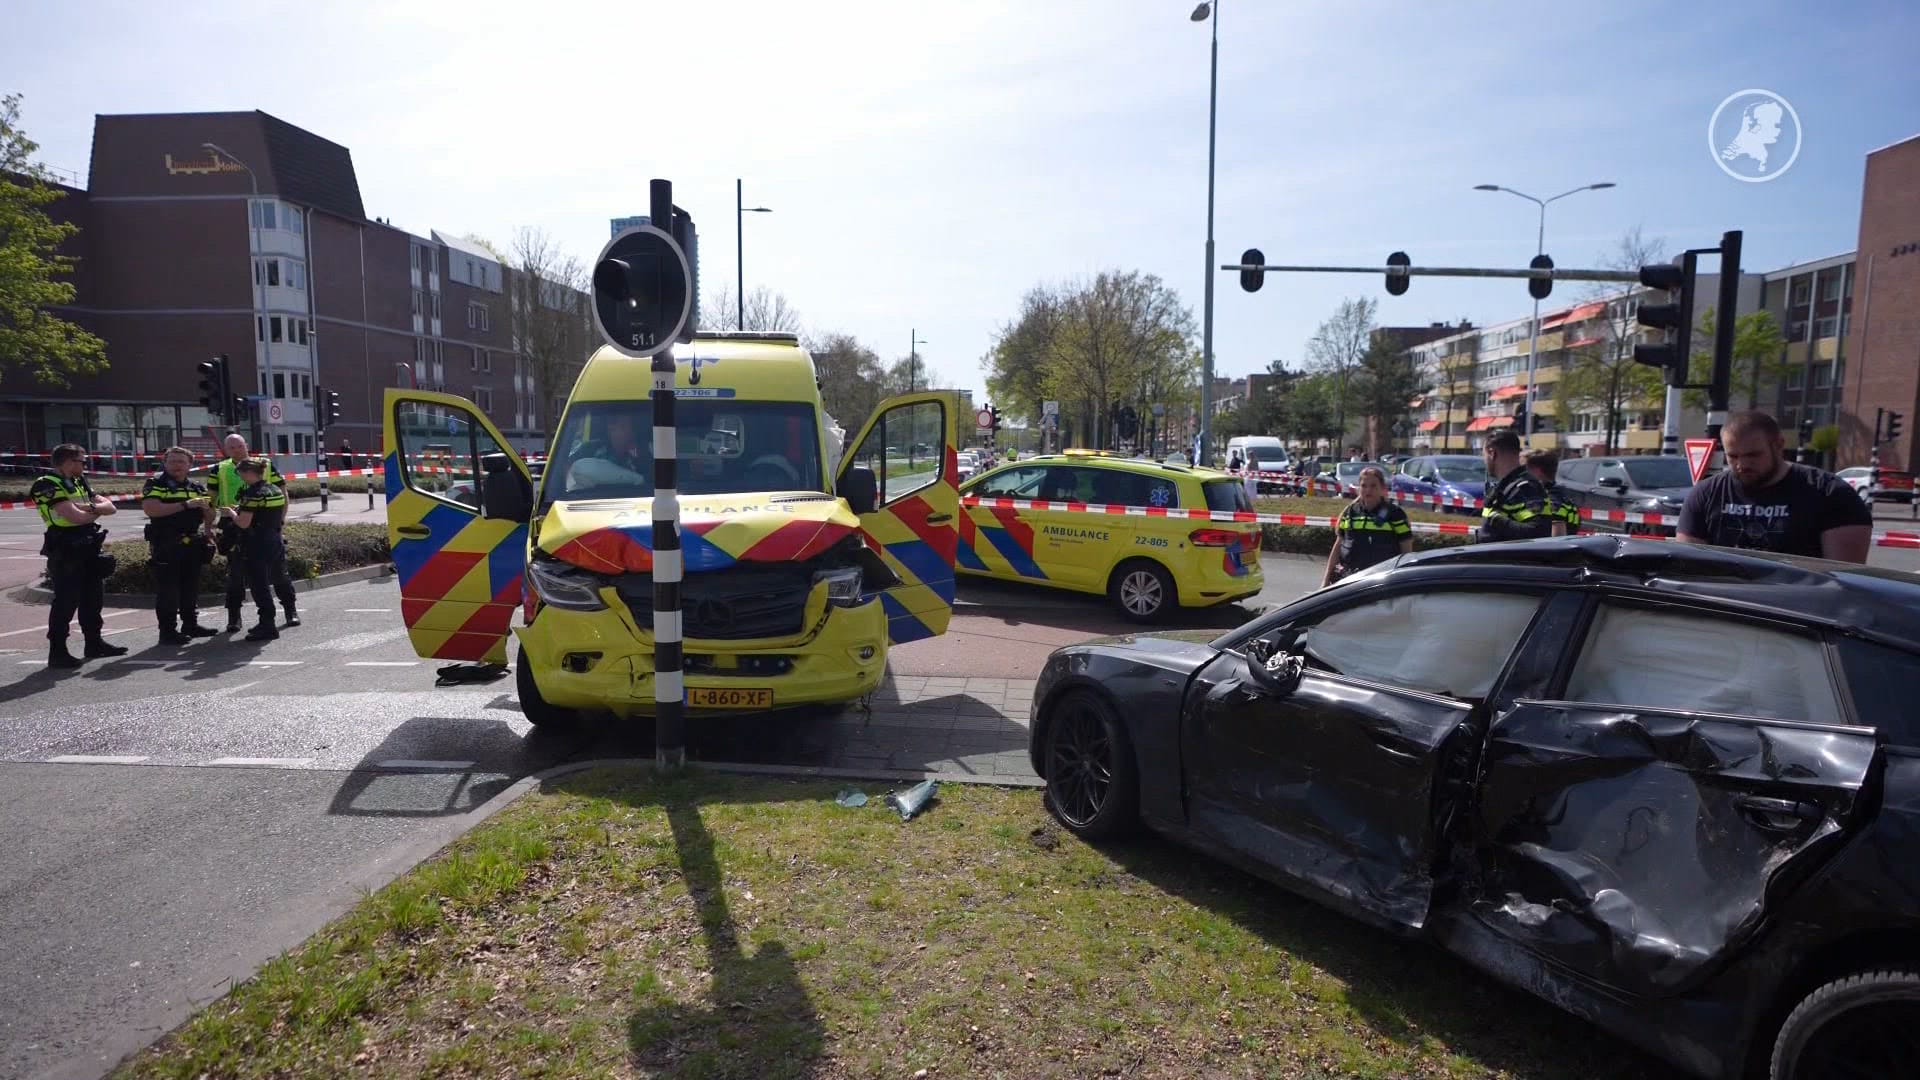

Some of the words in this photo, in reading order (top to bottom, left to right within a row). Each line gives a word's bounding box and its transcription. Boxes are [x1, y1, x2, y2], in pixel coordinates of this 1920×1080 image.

[632, 333, 655, 346] 51.1
[655, 381, 666, 389] 18
[614, 504, 796, 519] AMULANCE
[1721, 503, 1752, 516] JUST
[1043, 525, 1110, 541] AMBULANCE
[1135, 535, 1169, 548] 22-805
[693, 690, 767, 705] L-860-XF
